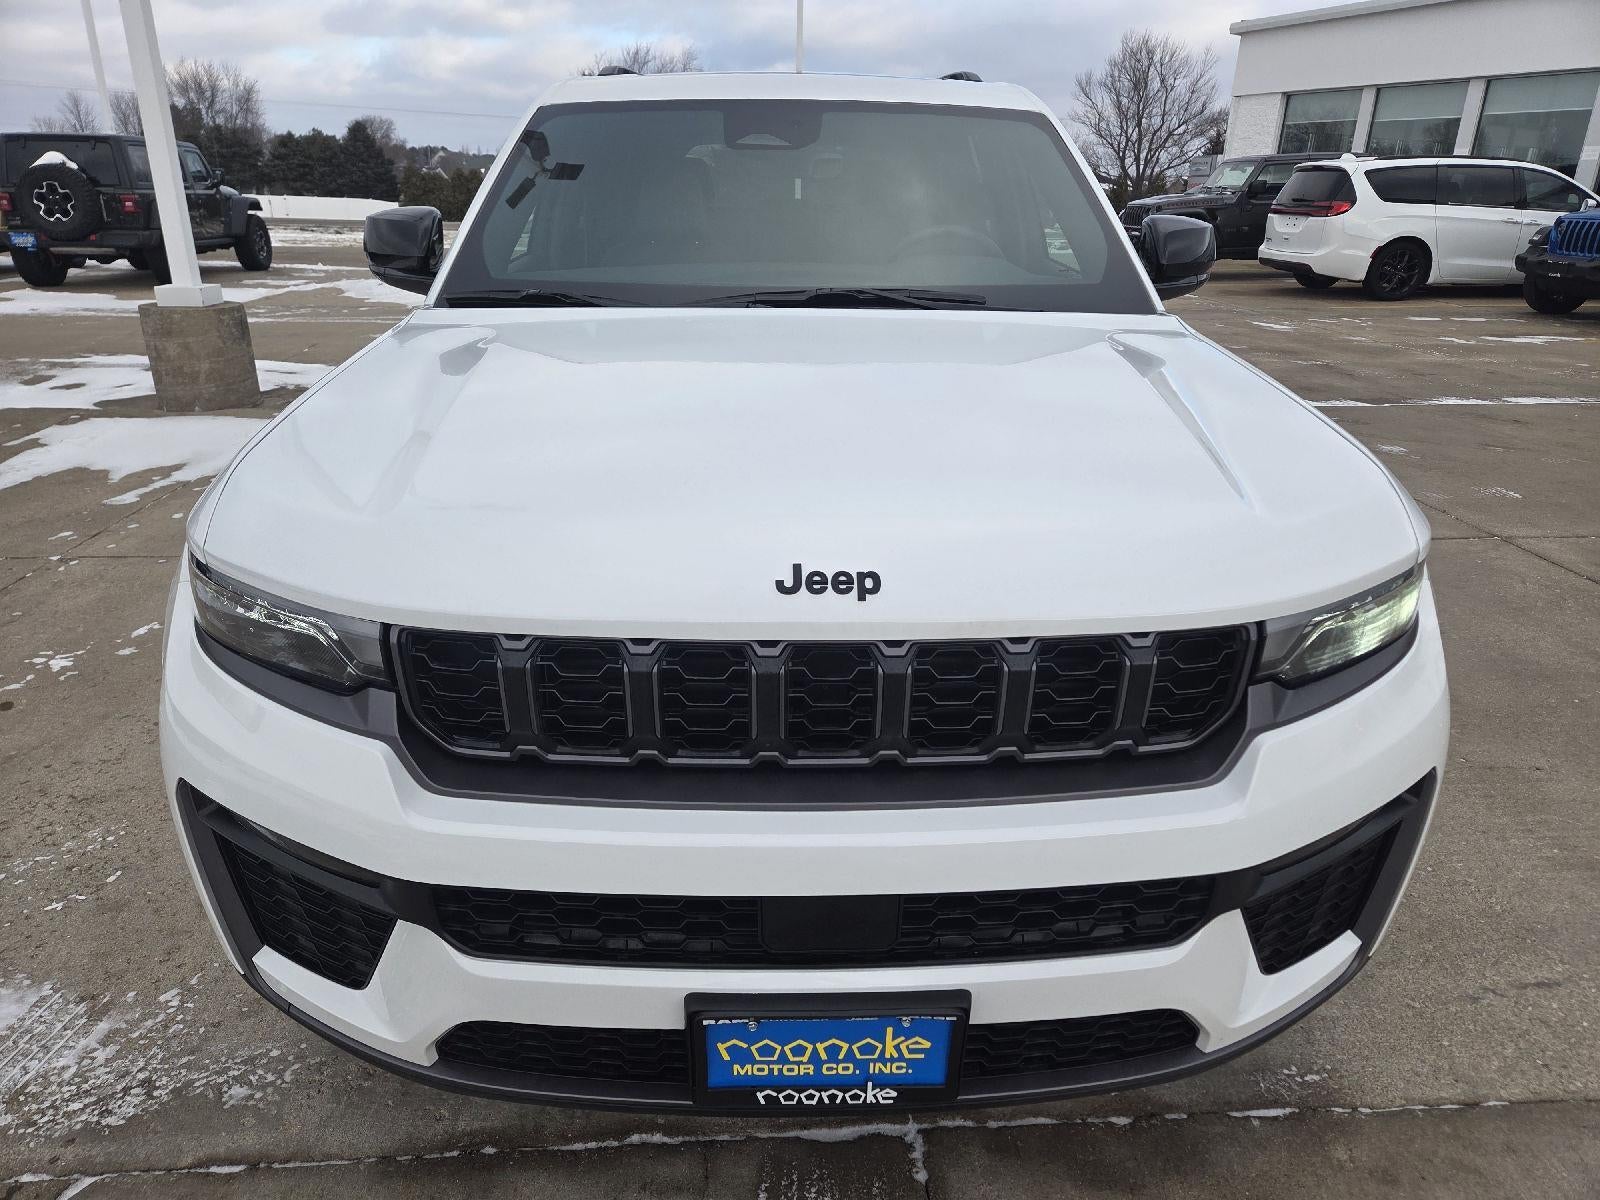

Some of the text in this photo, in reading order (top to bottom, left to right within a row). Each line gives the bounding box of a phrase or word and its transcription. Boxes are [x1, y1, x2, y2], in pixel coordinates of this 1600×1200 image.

[775, 563, 881, 601] Jeep
[716, 1026, 932, 1063] roanoke
[732, 1061, 913, 1076] MOTOR CO. INC.
[756, 1081, 898, 1105] roanoke
